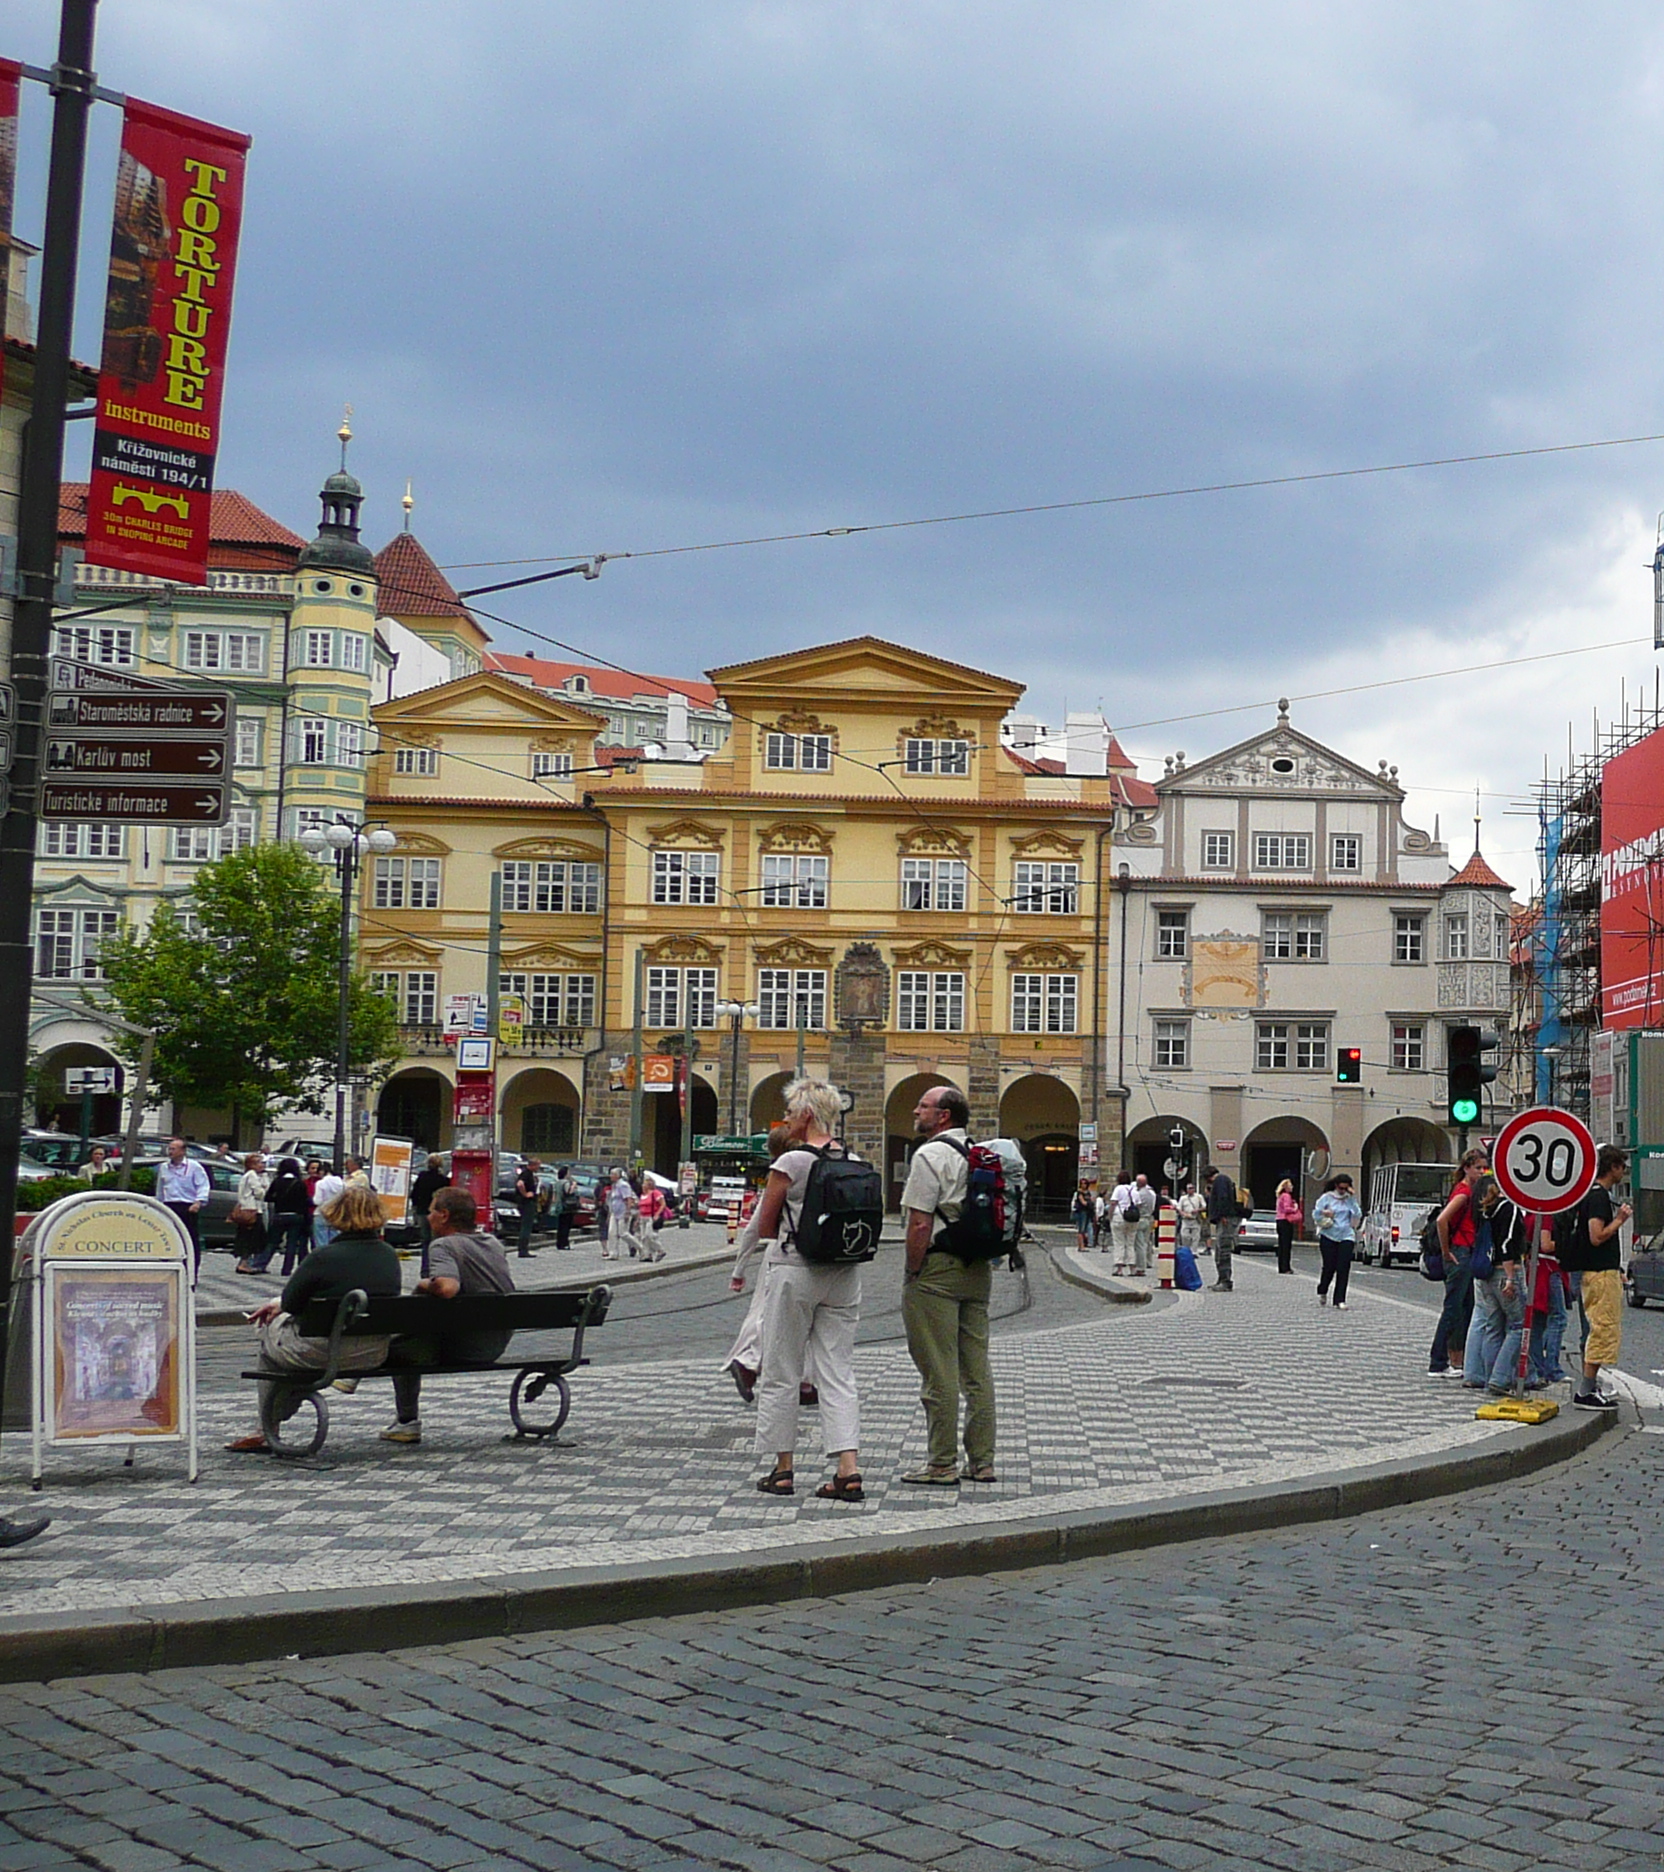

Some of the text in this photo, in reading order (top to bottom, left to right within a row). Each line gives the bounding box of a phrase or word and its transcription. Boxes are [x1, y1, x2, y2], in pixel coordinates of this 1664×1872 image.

[163, 157, 227, 411] TORTURE
[104, 399, 211, 440] instruments
[117, 438, 197, 469] Křižovnické
[101, 456, 207, 489] náměstí 194/1
[125, 516, 162, 532] CHARLES
[163, 523, 194, 539] BRIDGE
[155, 535, 189, 550] ARCADE
[80, 701, 193, 722] Staroměstská radnice
[76, 746, 151, 767] Karlův most
[45, 790, 168, 813] Turistické informace
[1513, 1133, 1575, 1187] 30
[74, 1240, 155, 1253] CONCERT
